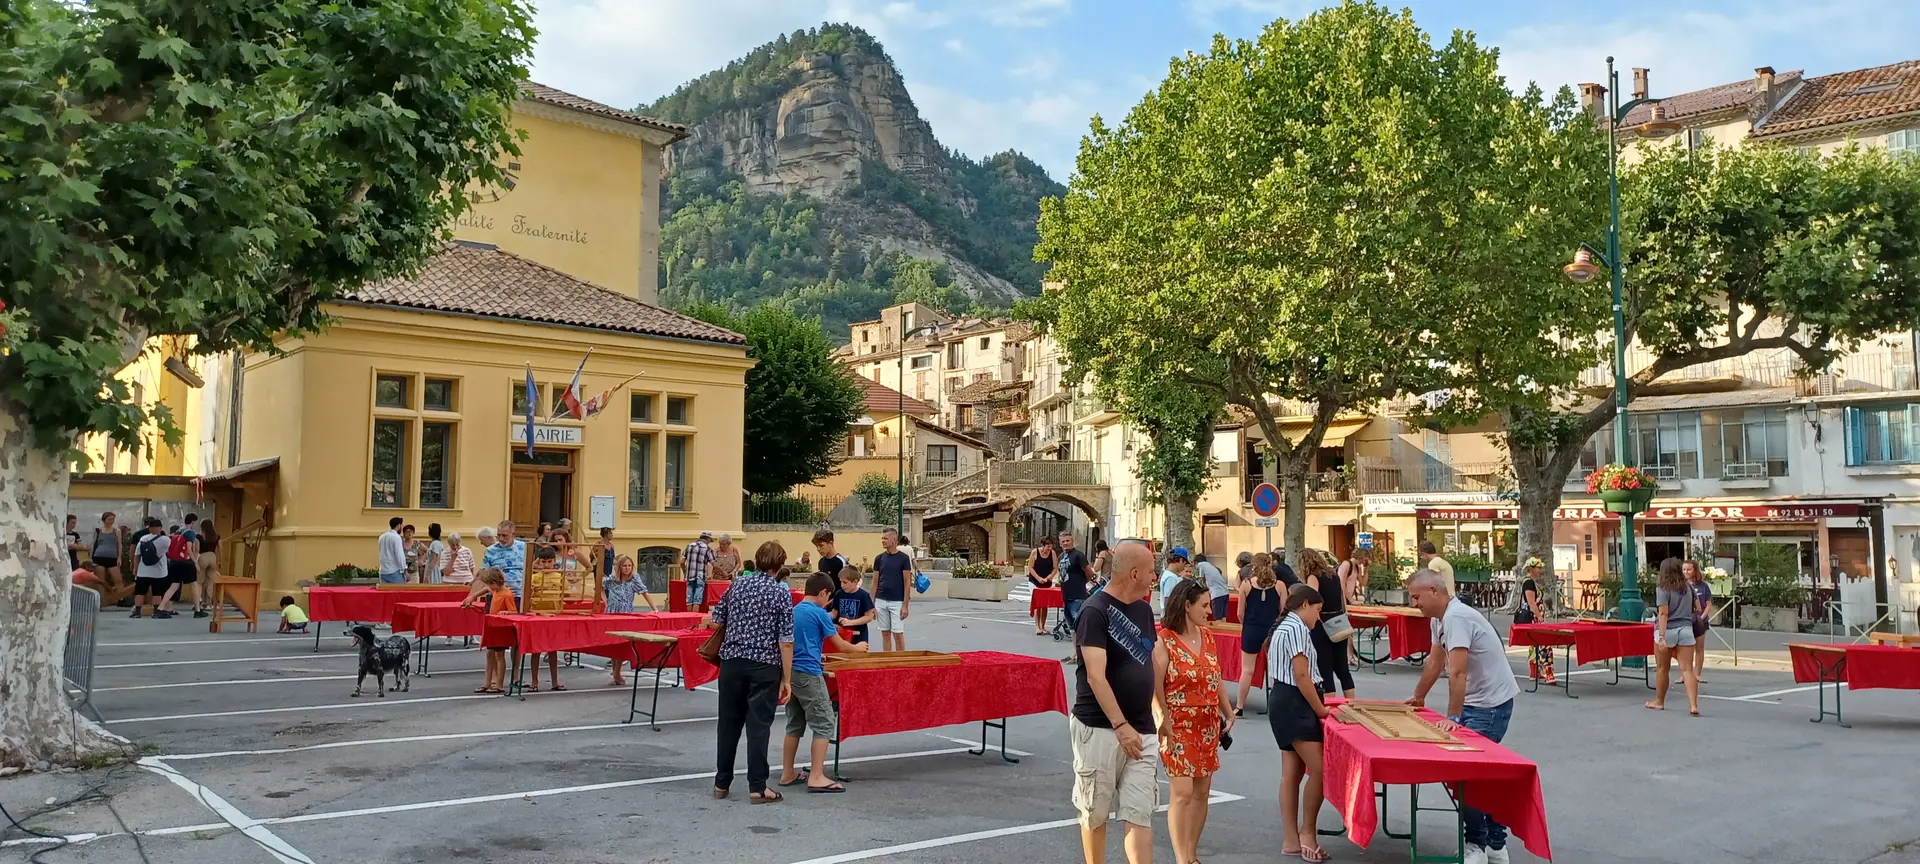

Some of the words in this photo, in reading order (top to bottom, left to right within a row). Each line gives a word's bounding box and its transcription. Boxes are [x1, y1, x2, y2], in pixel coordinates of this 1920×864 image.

[511, 214, 588, 244] Fraternité
[1497, 508, 1607, 519] PIERIA
[1656, 507, 1744, 518] CESAR
[1767, 509, 1778, 517] 04
[1780, 509, 1791, 517] 92
[1794, 509, 1805, 517] 83
[1808, 508, 1818, 516] 31
[1822, 508, 1833, 516] 50
